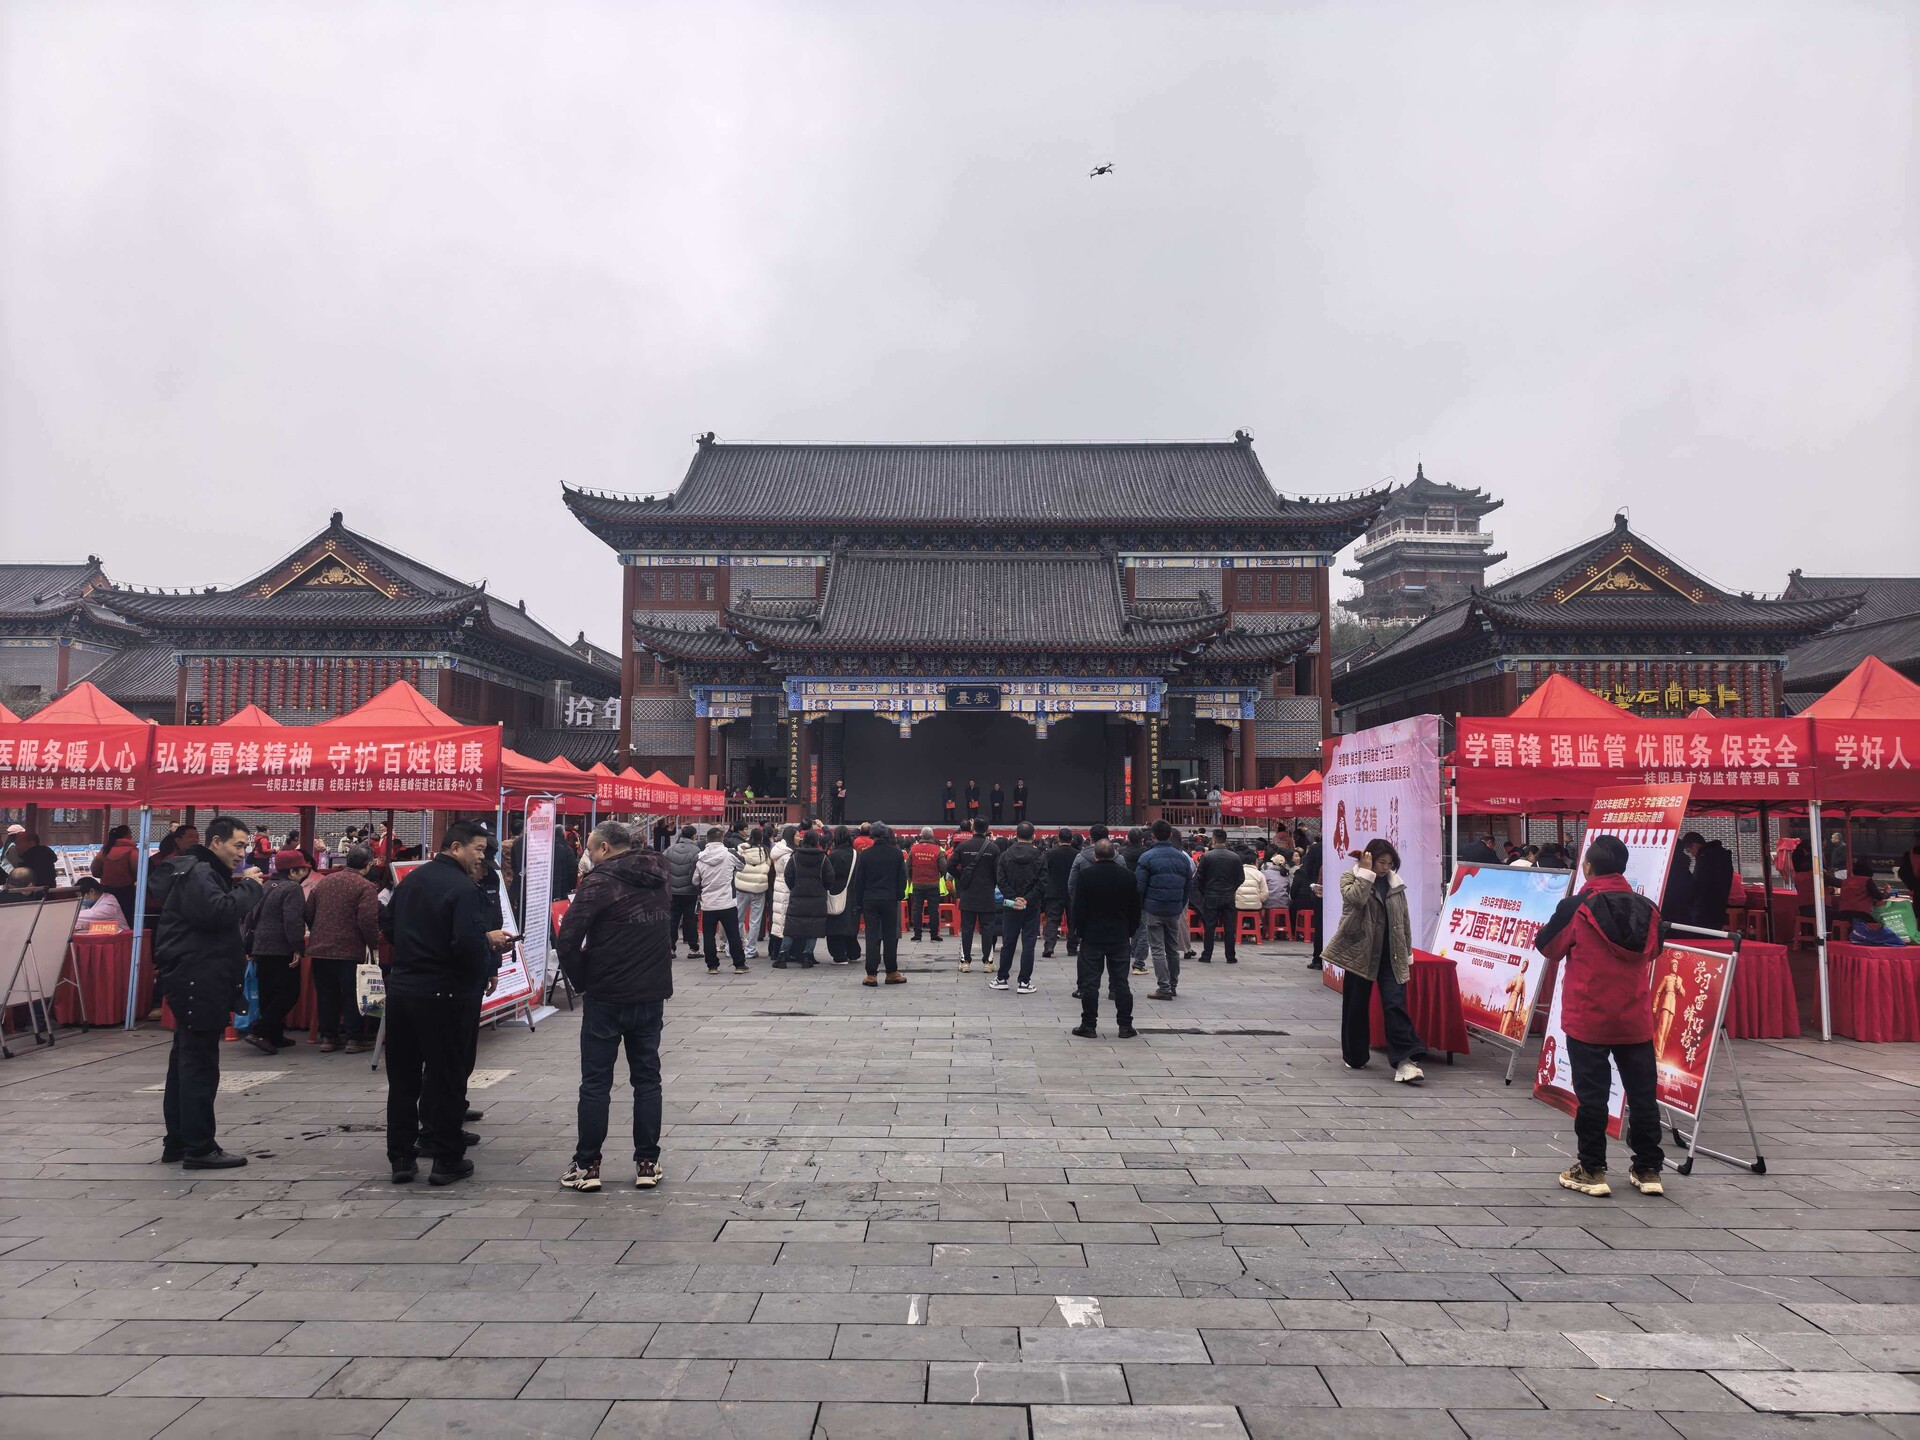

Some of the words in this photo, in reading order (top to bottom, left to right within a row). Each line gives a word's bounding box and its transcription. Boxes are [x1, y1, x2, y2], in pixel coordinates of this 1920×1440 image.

[0, 739, 136, 774] 医服务暖人心
[156, 741, 312, 775] 弘扬雷锋精神
[327, 740, 484, 775] 守护百姓健康
[1465, 733, 1542, 767] 学雷锋
[1550, 734, 1626, 768] 强监管
[1635, 734, 1712, 768] 优服务
[1720, 733, 1798, 768] 保安全
[1835, 735, 1911, 769] 学好人
[1, 776, 54, 790] 桂阳县计生协
[61, 777, 123, 791] 桂阳县中医医院
[126, 778, 136, 791] 宣
[330, 778, 373, 792] 桂阳县计生协
[475, 778, 483, 791] 宣
[1787, 771, 1800, 786] 宣
[1355, 806, 1377, 832] 签名墙
[1449, 908, 1545, 951] 学习雷锋好榜样
